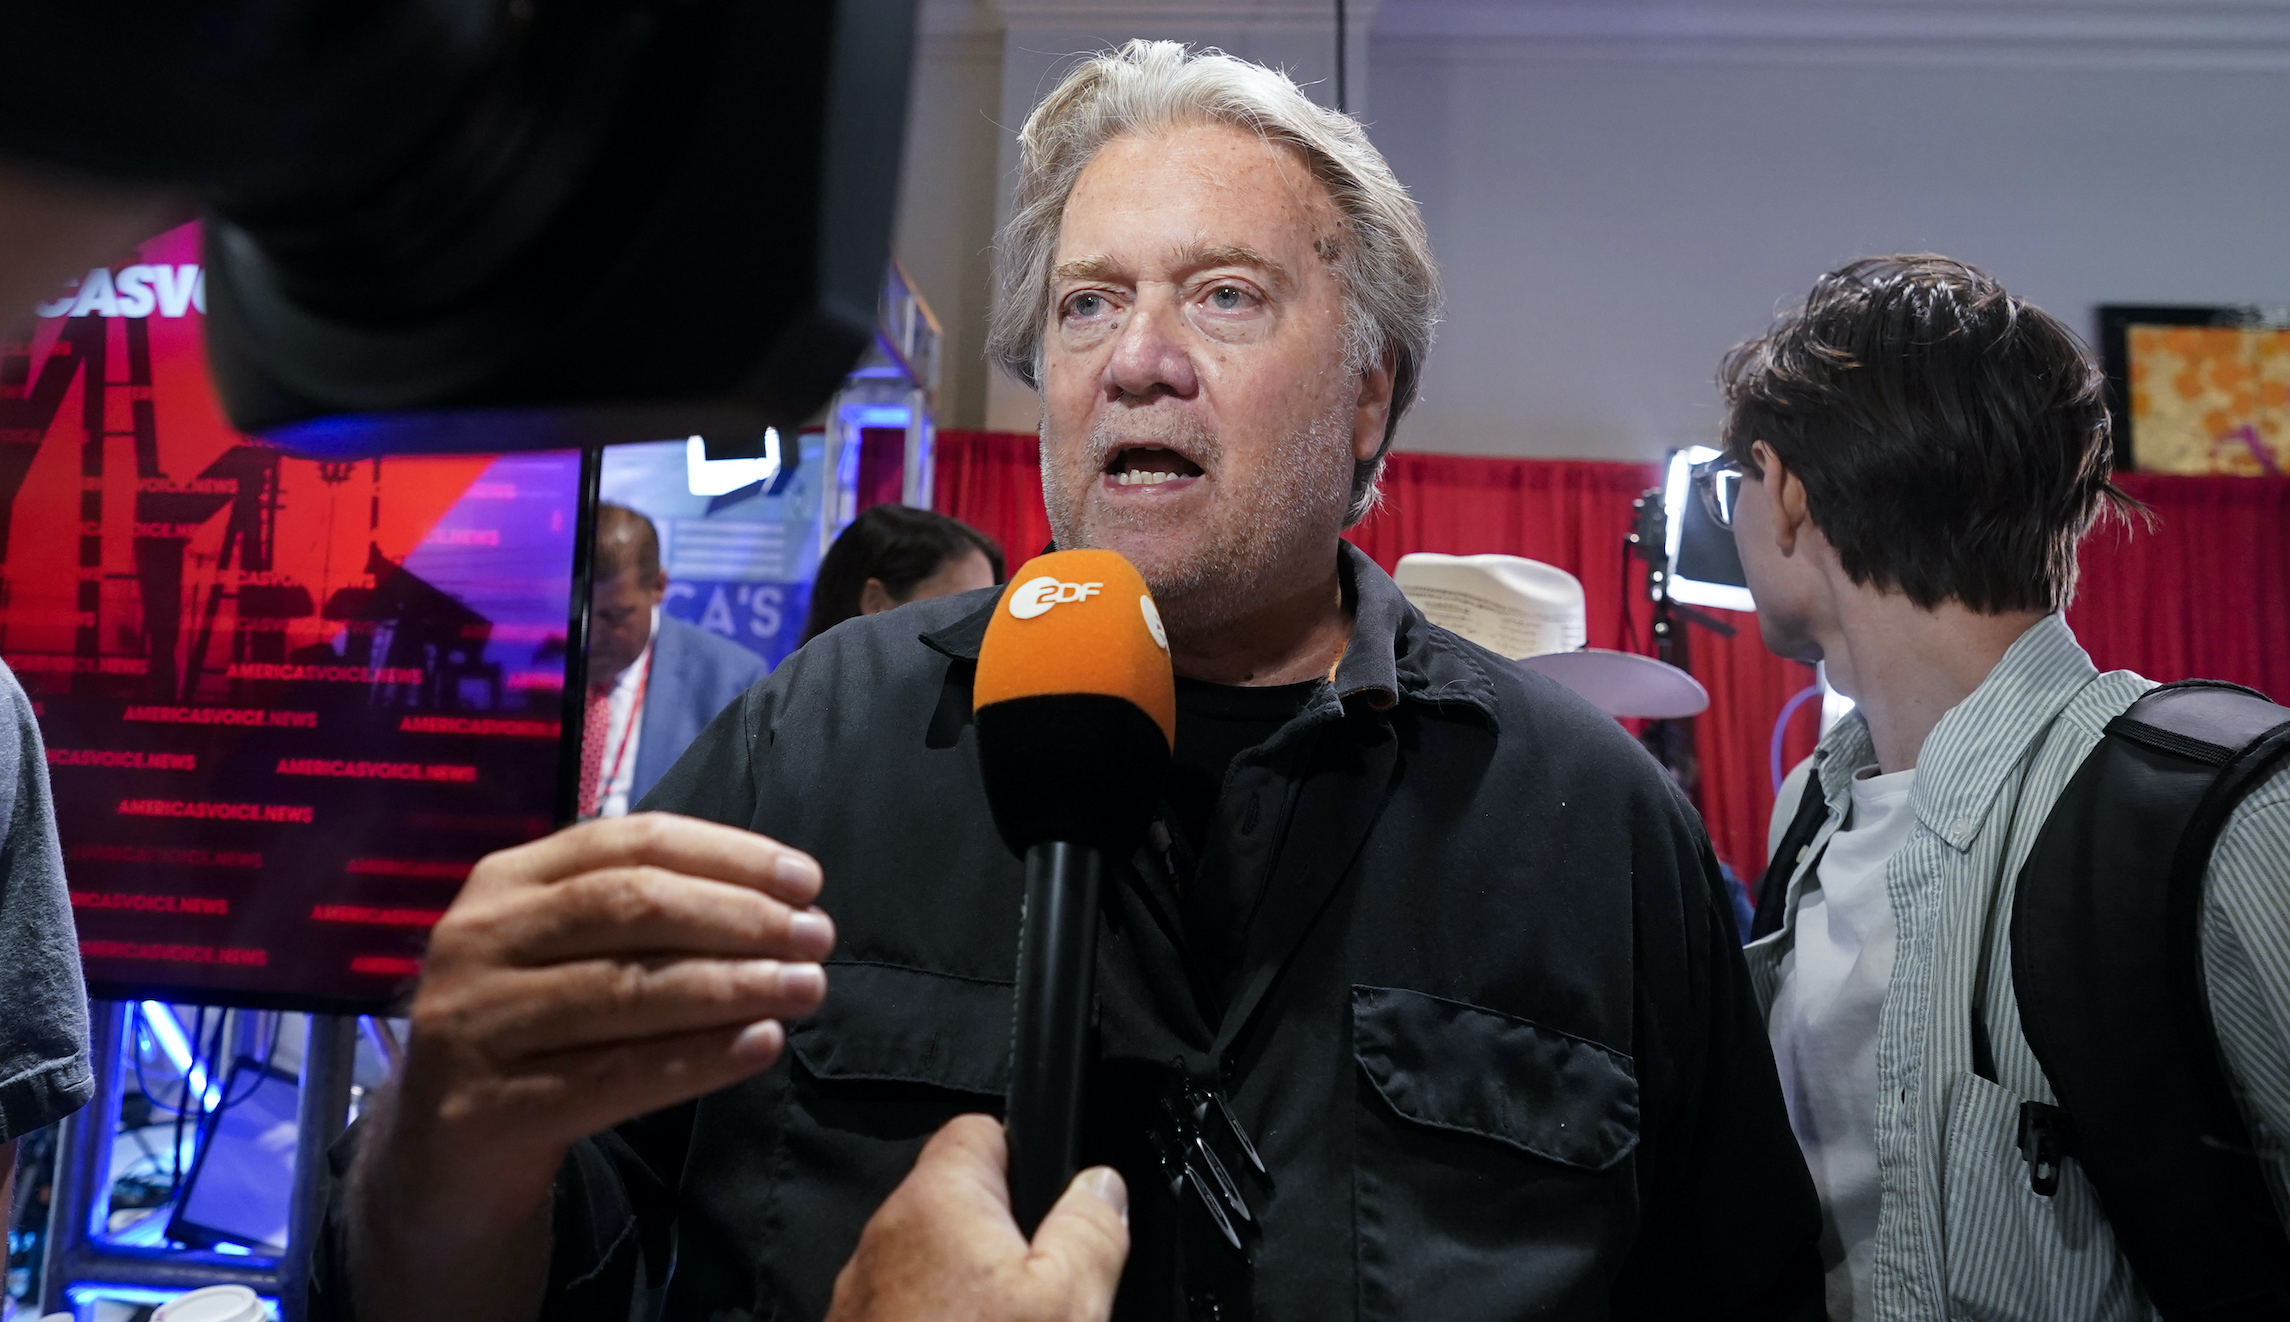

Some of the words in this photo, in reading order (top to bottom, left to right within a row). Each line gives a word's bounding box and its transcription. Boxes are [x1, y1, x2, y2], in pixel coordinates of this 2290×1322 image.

[225, 663, 422, 685] AMERICASVOICE.NEWS
[122, 705, 317, 728] AMERICASVOICE.NEWS
[276, 758, 477, 782] AMERICASVOICE.NEWS
[117, 799, 313, 824] AMERICASVOICE.NEWS
